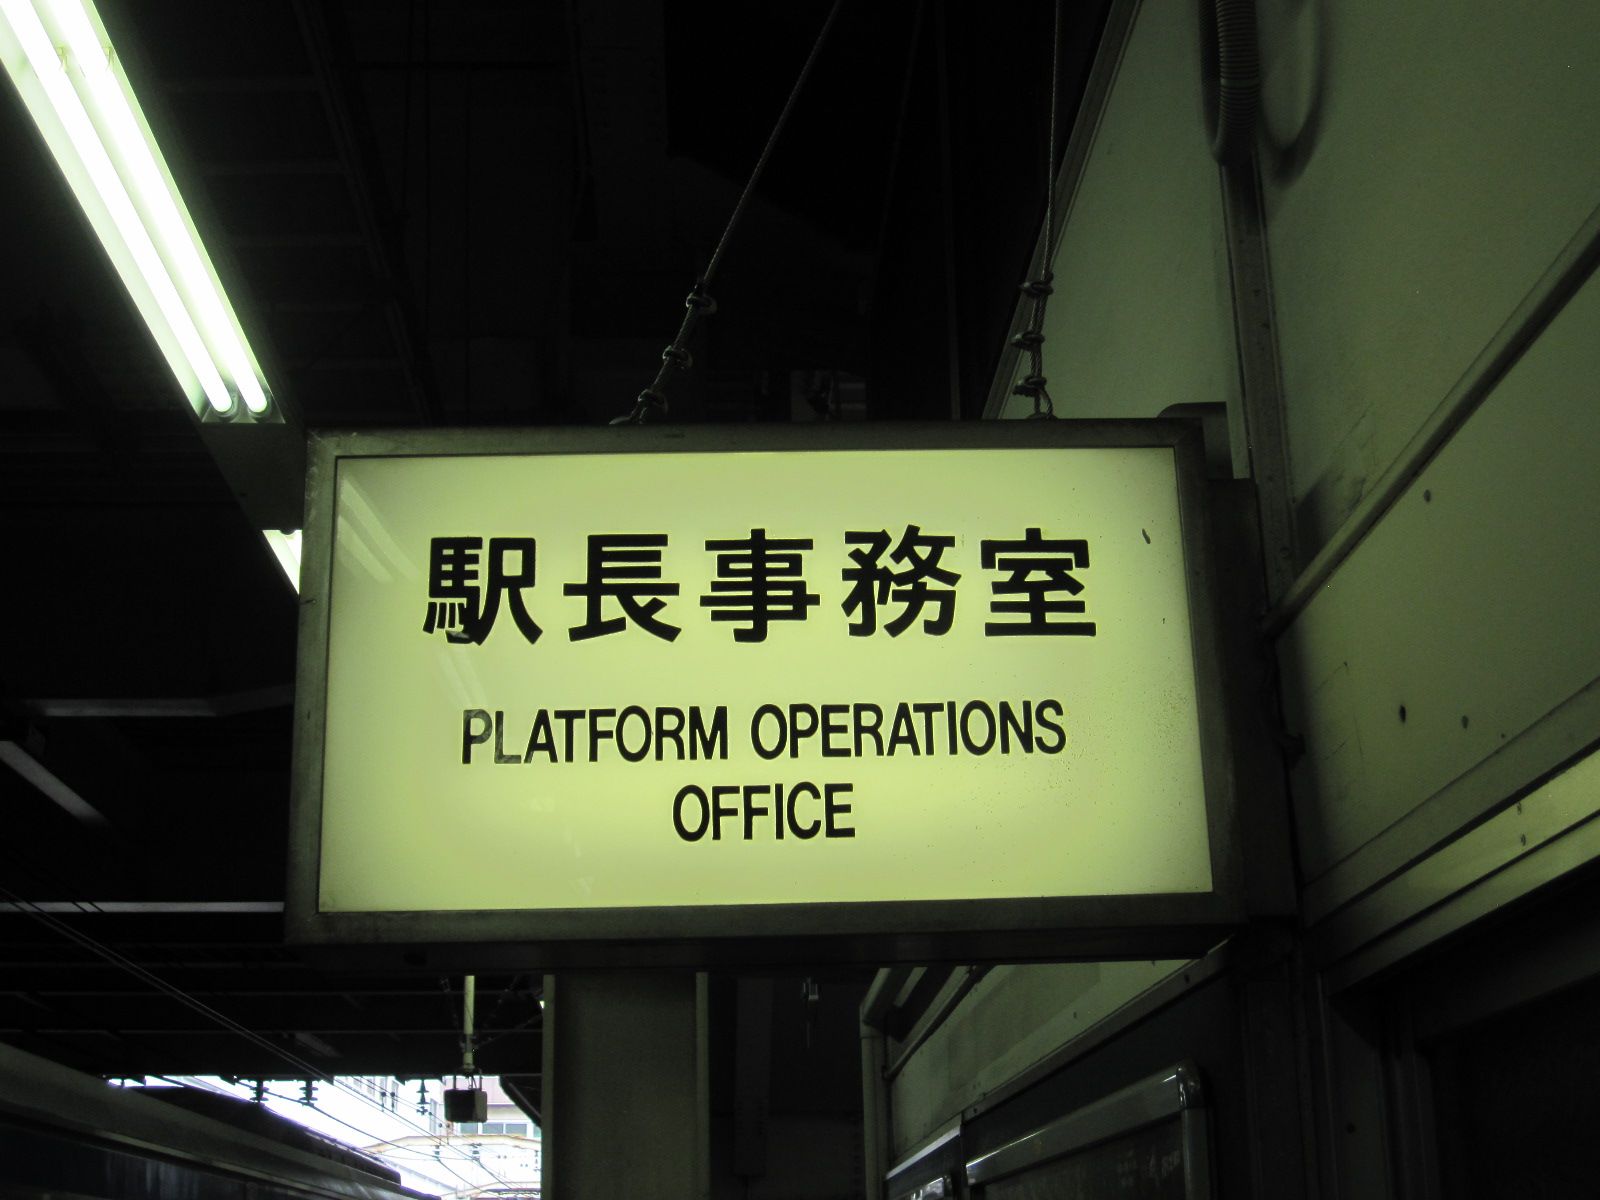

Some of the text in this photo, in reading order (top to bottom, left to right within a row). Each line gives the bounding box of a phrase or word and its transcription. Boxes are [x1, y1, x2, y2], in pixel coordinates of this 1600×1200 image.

[423, 525, 1096, 645] 駅長事務室
[462, 699, 1066, 764] PLATFORM OPERATIONS
[673, 782, 855, 841] OFFICE
